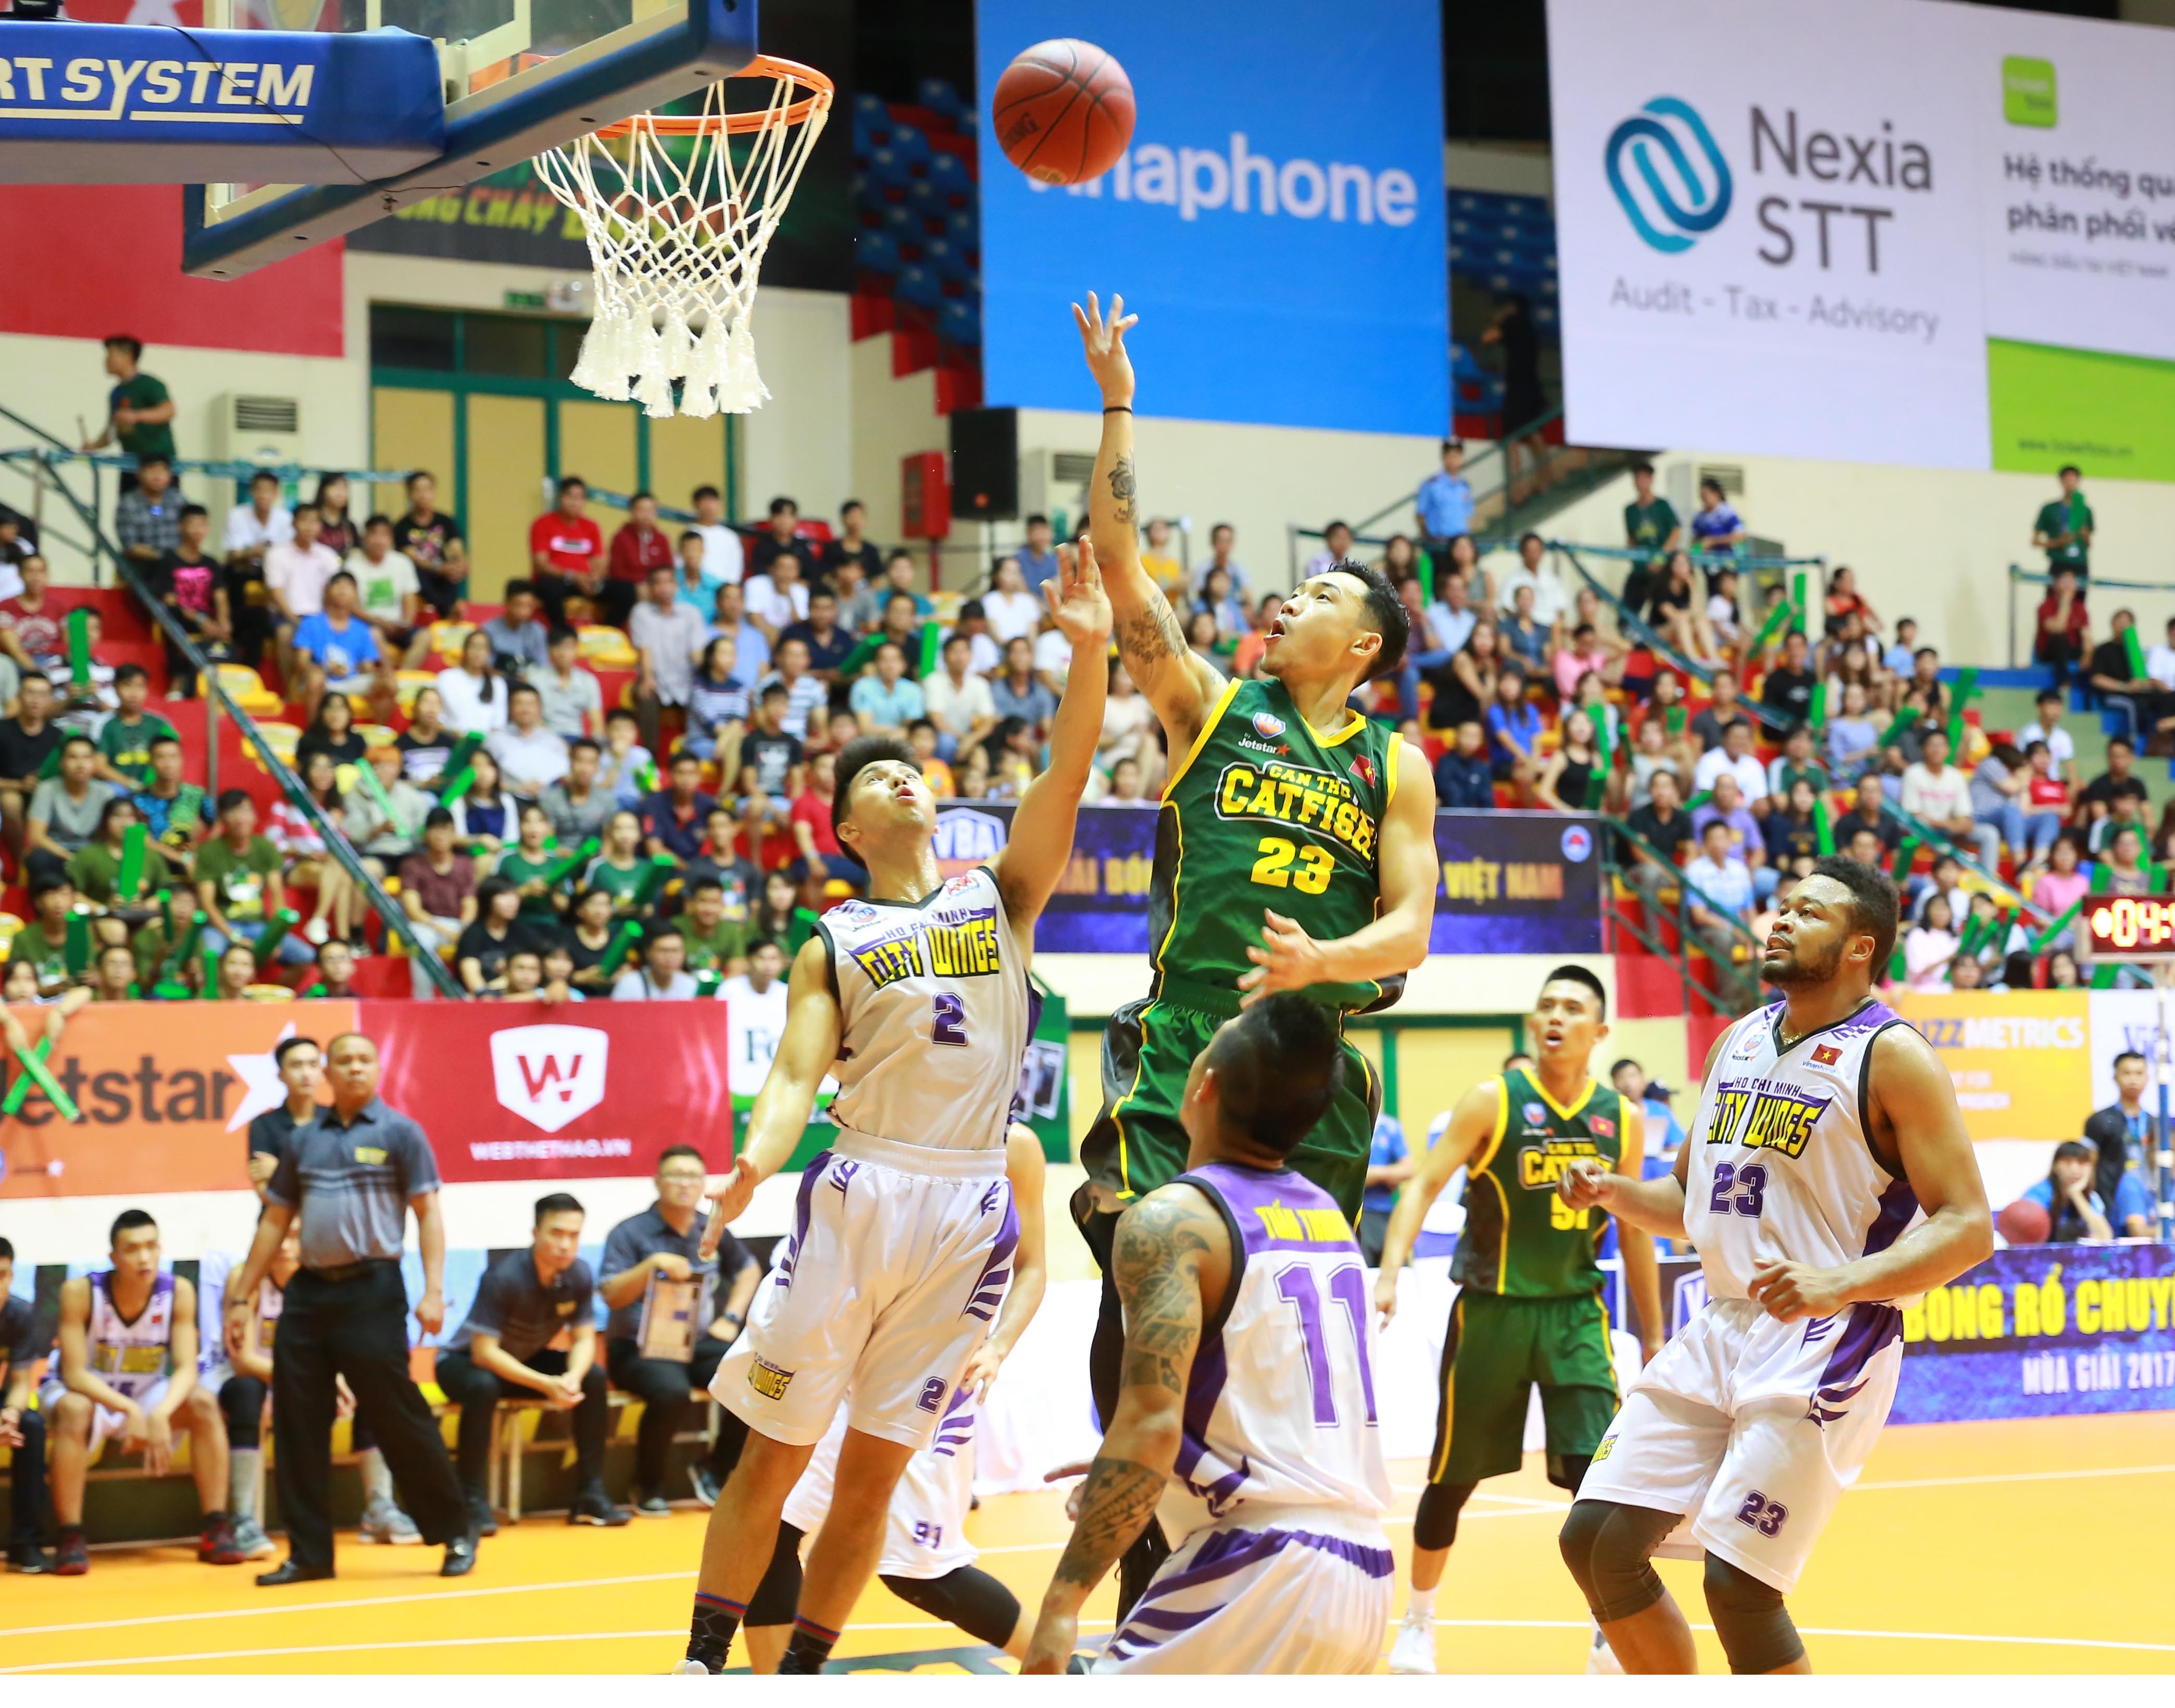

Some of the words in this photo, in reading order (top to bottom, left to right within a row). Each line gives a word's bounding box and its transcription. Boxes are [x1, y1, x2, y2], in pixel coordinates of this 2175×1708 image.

[60, 57, 315, 121] SYSTEM
[1749, 105, 1933, 192] Nexia
[1758, 196, 1894, 275] STT
[1609, 275, 1695, 317] Audit
[1723, 283, 1780, 322] Tax
[1808, 293, 1940, 345] Advisory
[1238, 737, 1278, 755] Jetstar
[1269, 764, 1312, 787] CAN
[1251, 836, 1335, 895] 23
[1505, 862, 1564, 900] NAM
[924, 916, 1000, 977] WINGS
[932, 991, 968, 1046] 2
[1734, 1077, 1749, 1088] HO
[1751, 1078, 1772, 1092] CHI
[1774, 1082, 1802, 1097] MINH
[1802, 1060, 1836, 1075] vinaphone
[1743, 1096, 1824, 1157] WINGS
[1708, 1161, 1768, 1219] 23
[2014, 1263, 2066, 1338] RỔ
[1274, 1261, 1379, 1428] 11
[2022, 1351, 2070, 1396] MÙA
[2127, 1350, 2175, 1390] 2017
[916, 1375, 948, 1414] 2
[1734, 1489, 1790, 1539] 23
